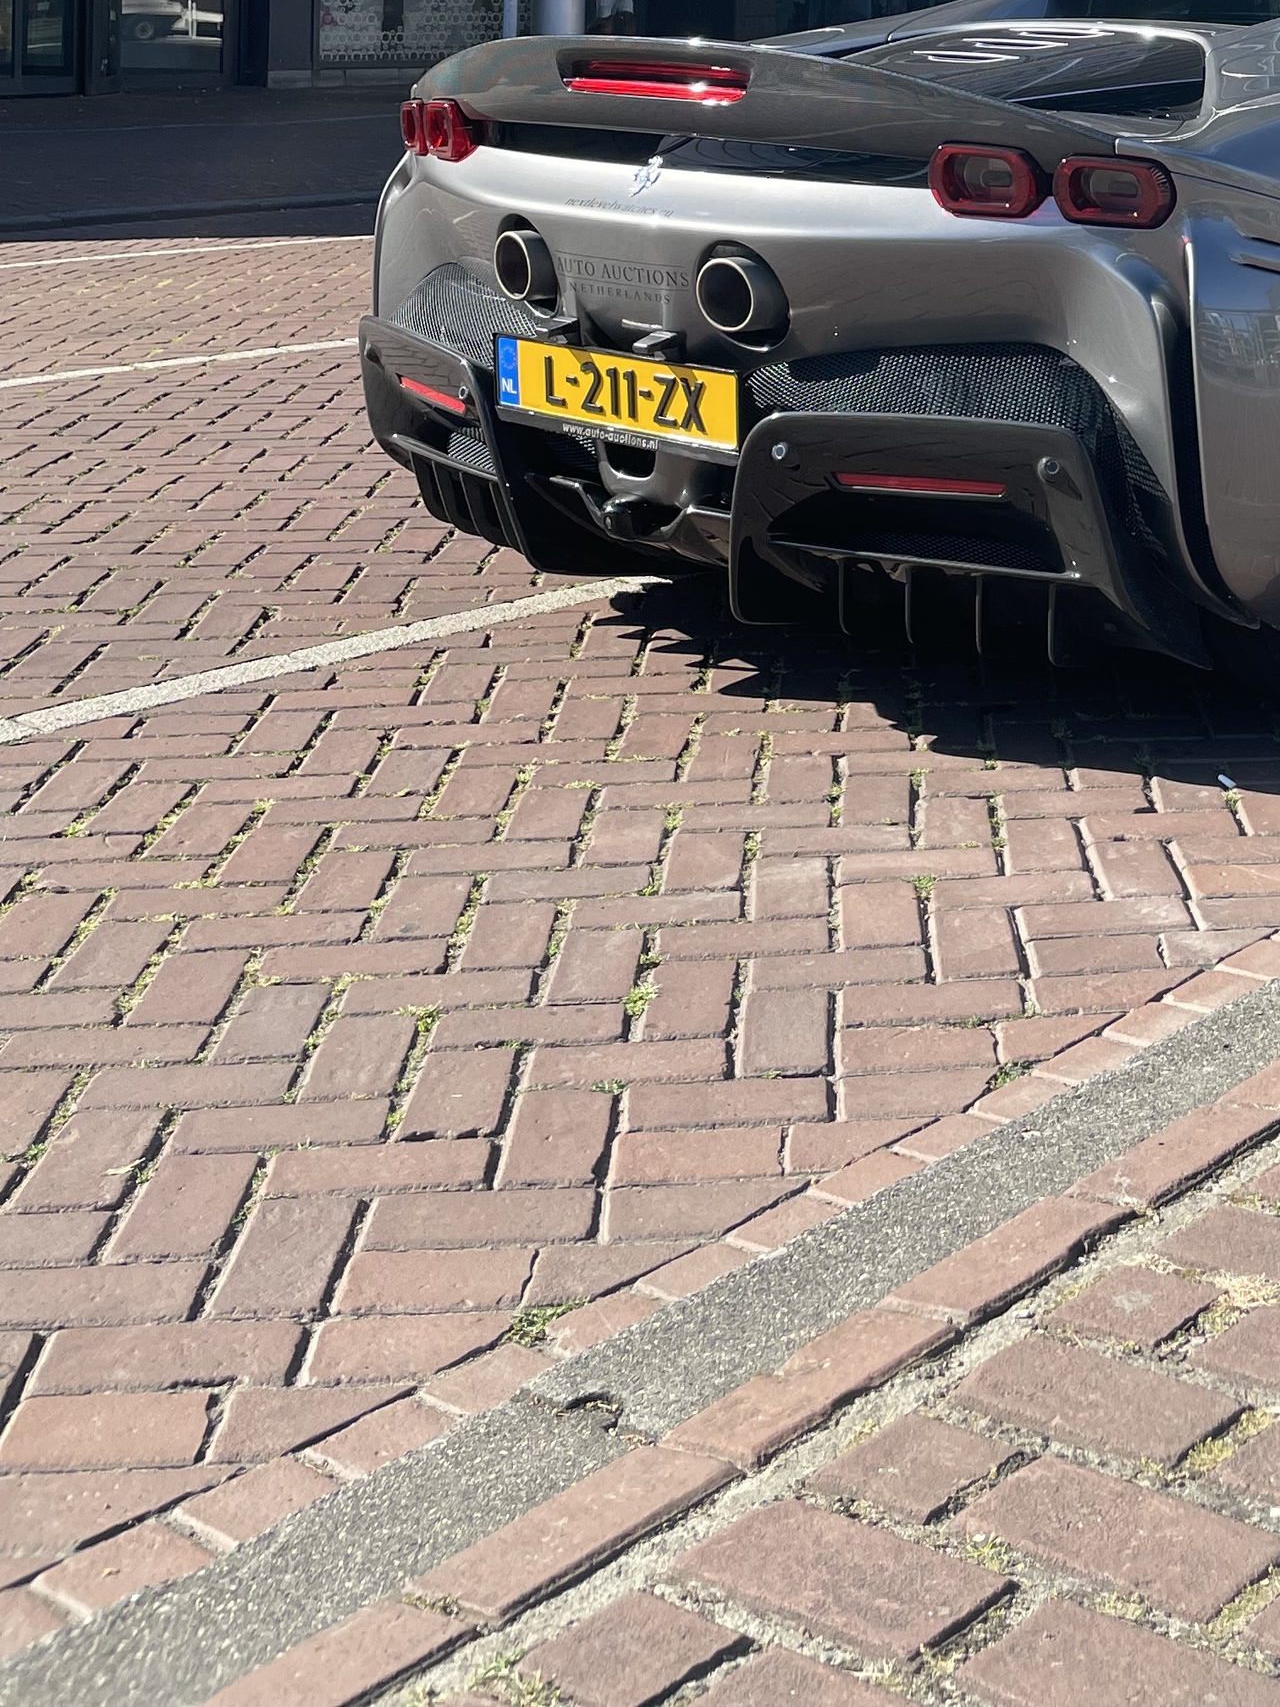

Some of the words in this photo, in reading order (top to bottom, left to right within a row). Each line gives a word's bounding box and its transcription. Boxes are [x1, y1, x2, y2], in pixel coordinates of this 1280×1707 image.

[565, 197, 674, 217] nextlevelwatcheseu
[557, 256, 595, 276] AUTO
[601, 263, 689, 287] AUCTIONS
[570, 281, 670, 304] NETHERLANDS
[501, 377, 517, 394] NL
[544, 355, 707, 435] L-211-ZX
[562, 423, 659, 450] www.auto-auctions.nl
